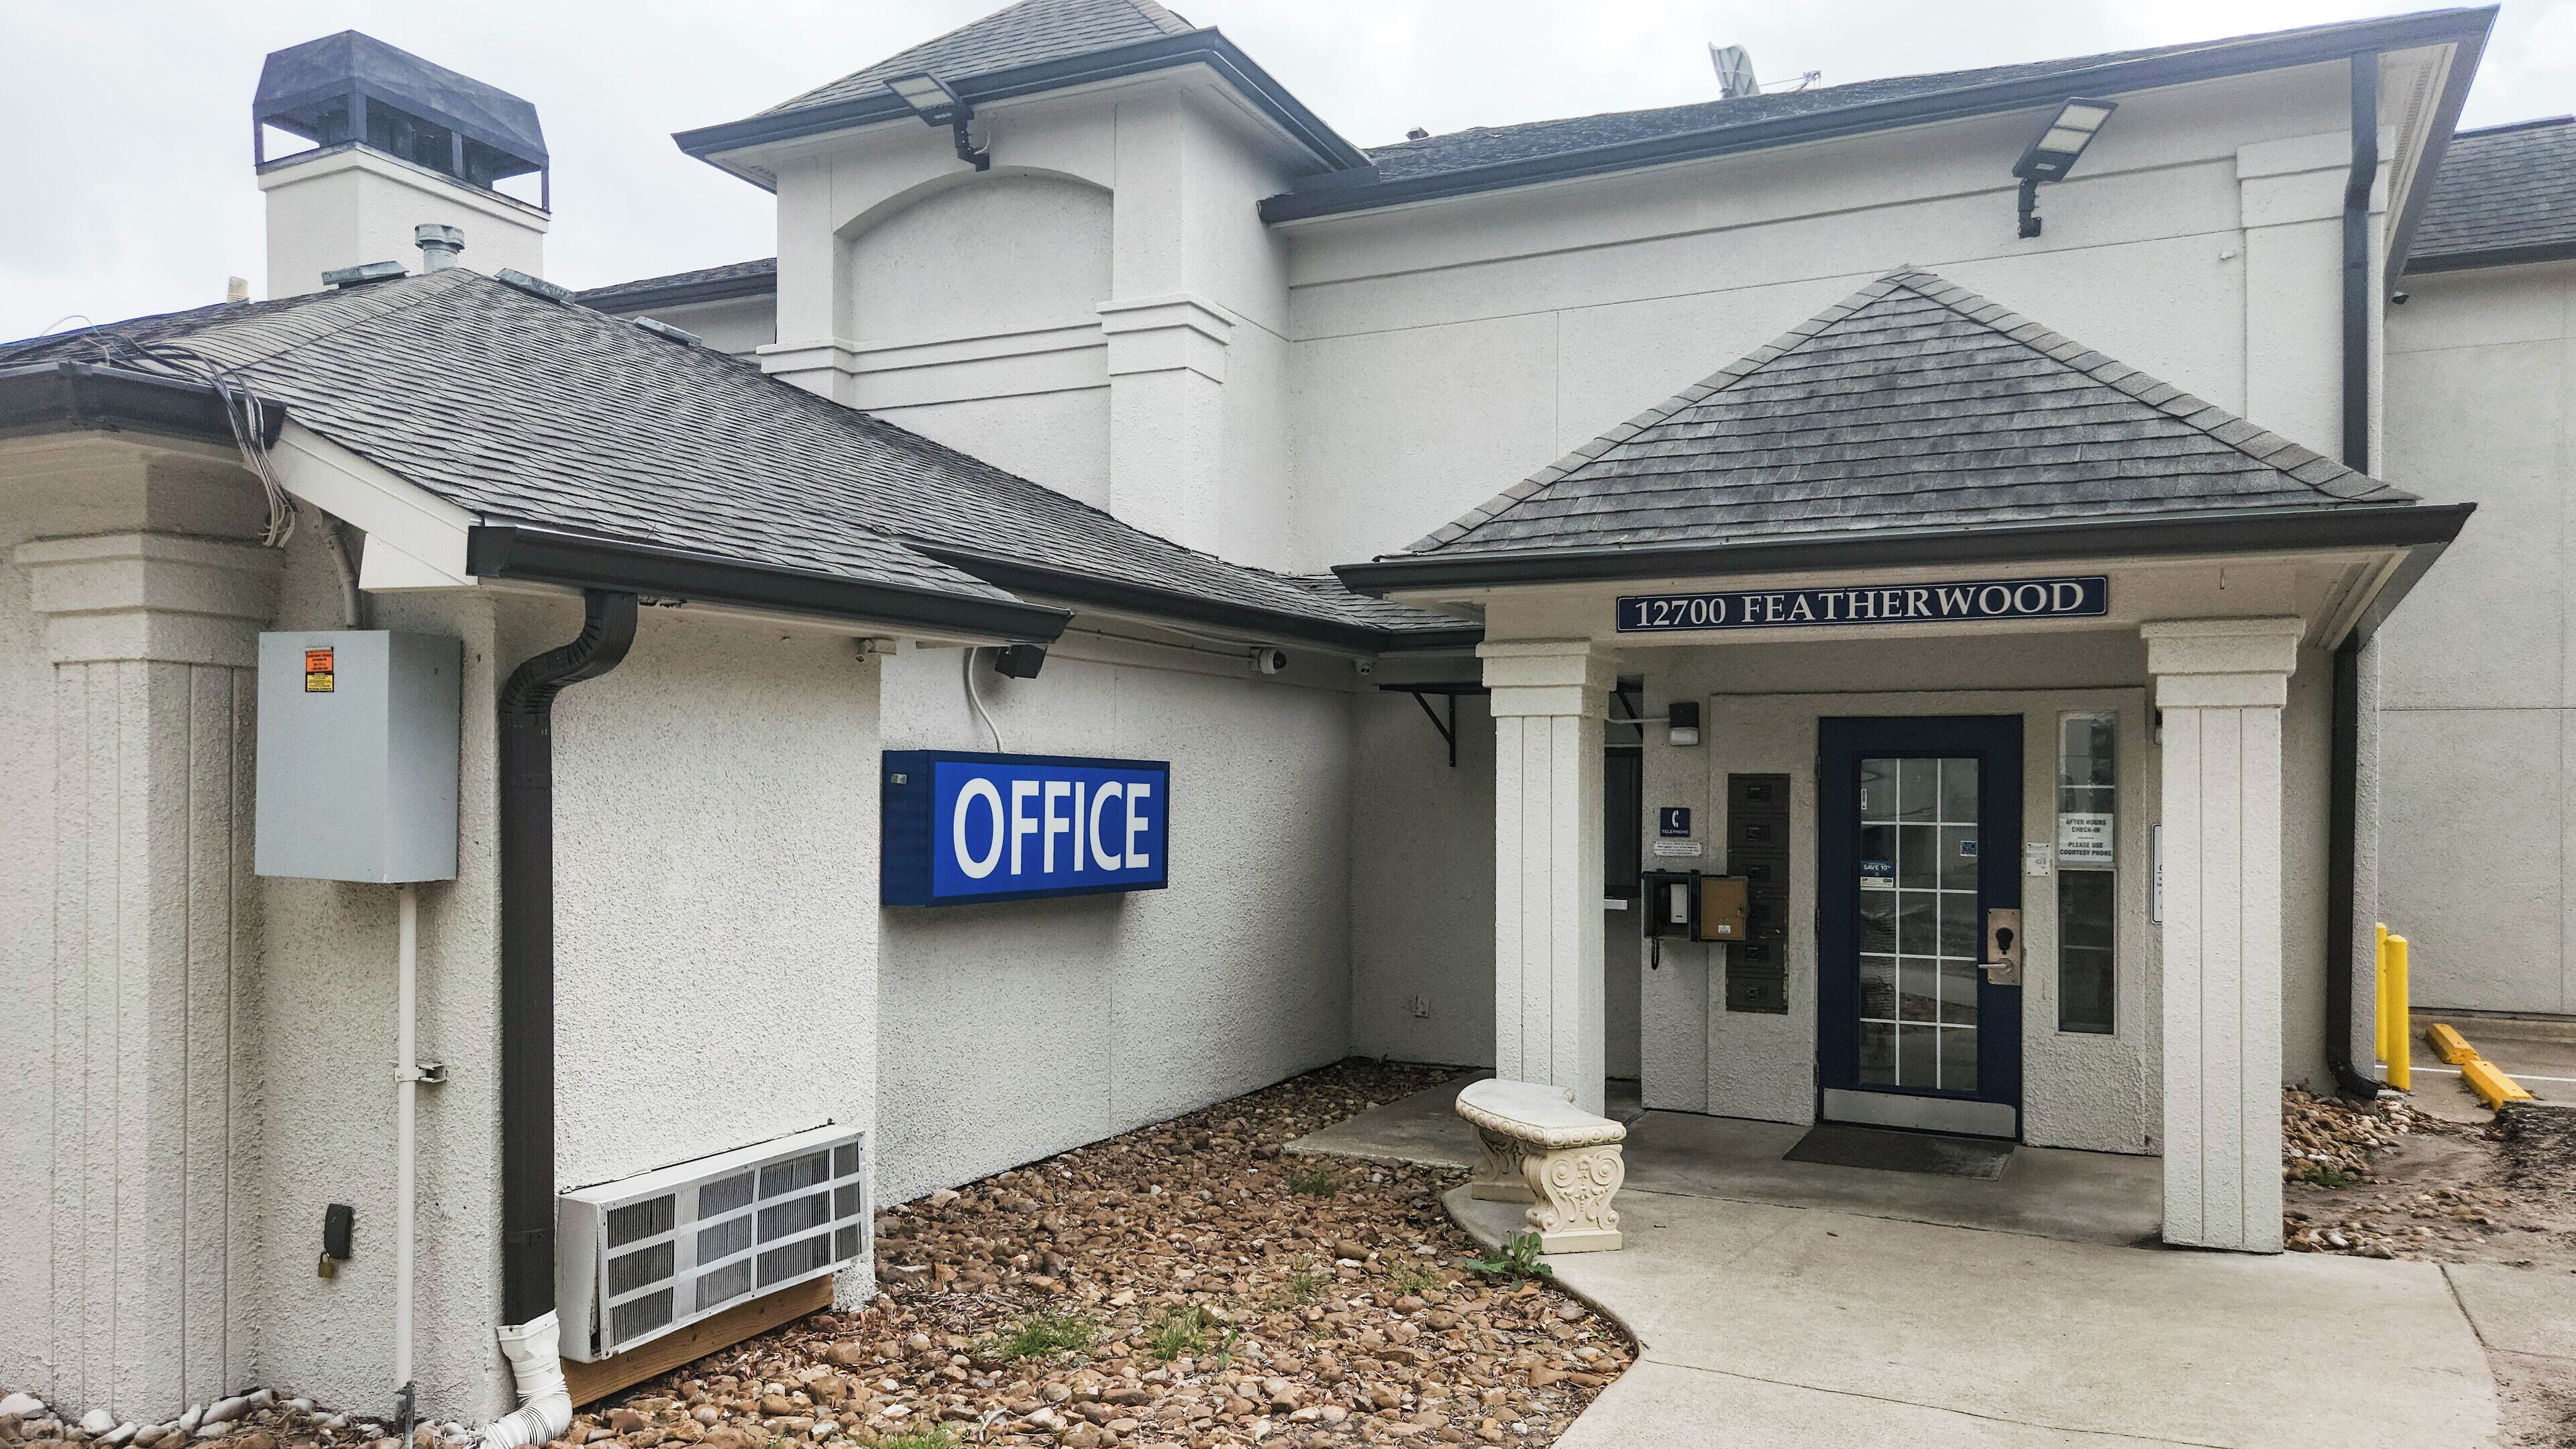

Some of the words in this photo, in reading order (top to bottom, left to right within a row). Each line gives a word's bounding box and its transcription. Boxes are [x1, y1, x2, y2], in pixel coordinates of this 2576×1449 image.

[1635, 598, 1726, 627] 12700
[1741, 582, 2084, 623] FEATHERWOOD
[953, 777, 1151, 879] OFFICE
